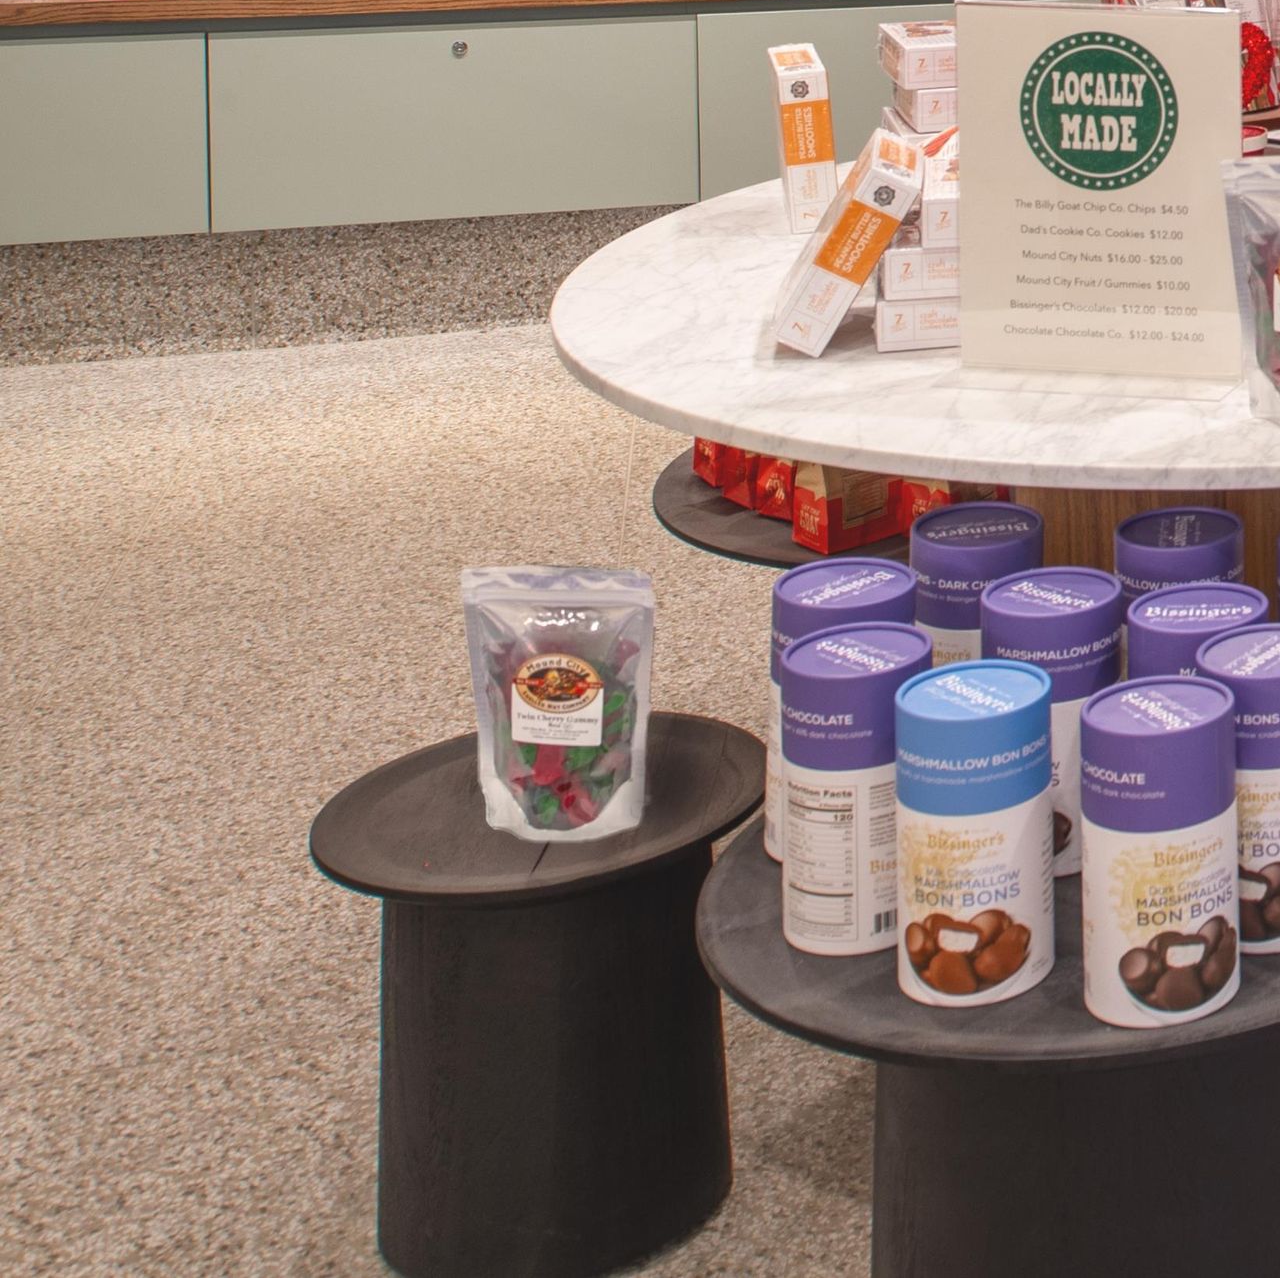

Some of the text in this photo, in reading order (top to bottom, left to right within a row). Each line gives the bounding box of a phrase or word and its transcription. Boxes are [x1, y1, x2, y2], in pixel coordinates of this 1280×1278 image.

[1051, 71, 1147, 107] LOCALLY
[803, 106, 817, 159] SMOOTHIES
[1060, 113, 1137, 152] MADE
[1015, 199, 1033, 209] The
[1035, 200, 1055, 212] Billy
[1057, 202, 1081, 211] Goat
[1083, 202, 1107, 213] Chip
[1127, 204, 1156, 215] Chips
[1161, 204, 1189, 215] $4.50
[1020, 225, 1047, 234] Dad's
[1049, 226, 1084, 236] Cookie
[1105, 229, 1144, 239] Cookies
[1149, 230, 1183, 240] $12.00
[841, 216, 882, 273] SMOOTHIES
[1022, 250, 1183, 266] Mound City Nuts $16.00 $25.00
[1016, 275, 1190, 291] Mound City Fruit Gummies $10.00
[1010, 299, 1198, 316] Bissinger's Chocolates $12.00 $20.00
[1003, 324, 1053, 336] Chocolate
[1055, 326, 1105, 338] Chocolate
[1129, 330, 1163, 340] $12.00
[1171, 331, 1205, 342] $24.00
[938, 578, 976, 591] DARK
[1144, 603, 1253, 619] Bissinger's
[997, 643, 1090, 662] MARSHMALLOW
[526, 658, 562, 673] Mound
[536, 714, 565, 724] Cherry
[1243, 712, 1280, 727] BONS
[828, 729, 873, 740] chocolate
[992, 748, 1020, 767] BON
[1083, 762, 1146, 786] CHOCOLATE
[823, 789, 853, 799] Facts
[1120, 789, 1166, 800] chocolate
[833, 814, 853, 822] 120
[927, 834, 1005, 851] Bissinger's
[1153, 836, 1224, 869] Bissinger's
[914, 869, 1021, 891] MARSHMALLOW
[1149, 867, 1227, 897] Dark Chocolate
[915, 883, 1021, 908] BON BONS
[1136, 876, 1233, 911] MARSHMALLOW
[1137, 886, 1234, 927] BON BONS
